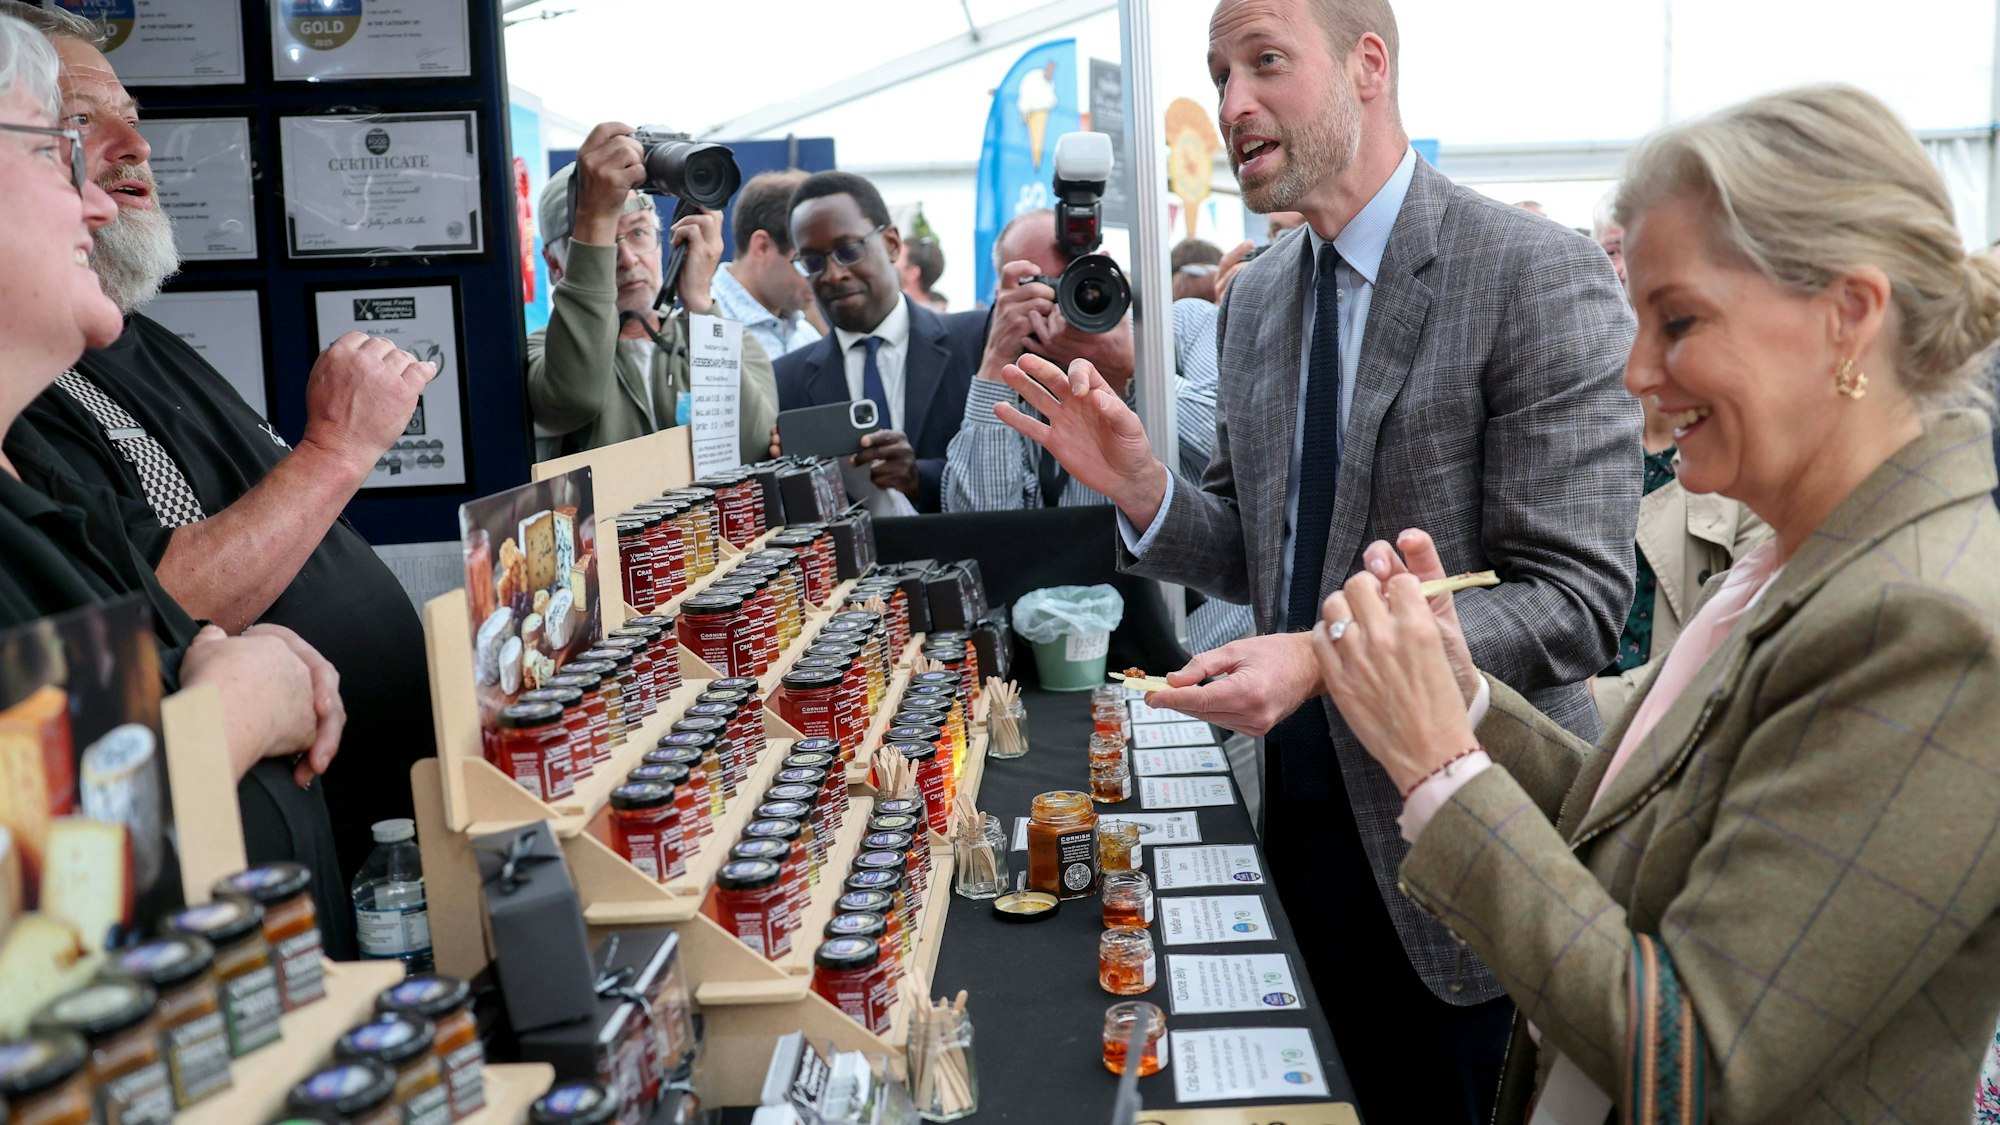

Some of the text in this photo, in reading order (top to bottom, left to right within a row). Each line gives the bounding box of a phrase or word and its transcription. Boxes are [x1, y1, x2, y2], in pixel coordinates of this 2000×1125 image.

[300, 20, 345, 35] GOLD
[328, 154, 430, 171] CERTIFICATE
[372, 298, 414, 307] HOME FARM
[374, 306, 414, 314] CORNWALL
[1060, 833, 1091, 843] CORNISH
[1158, 850, 1171, 869] Rosemary
[1160, 874, 1173, 886] Apple
[1167, 907, 1184, 934] Medlar Jelly
[1172, 967, 1191, 1000] Quince Jelly
[1180, 1039, 1201, 1092] Crab Apple Jelly
